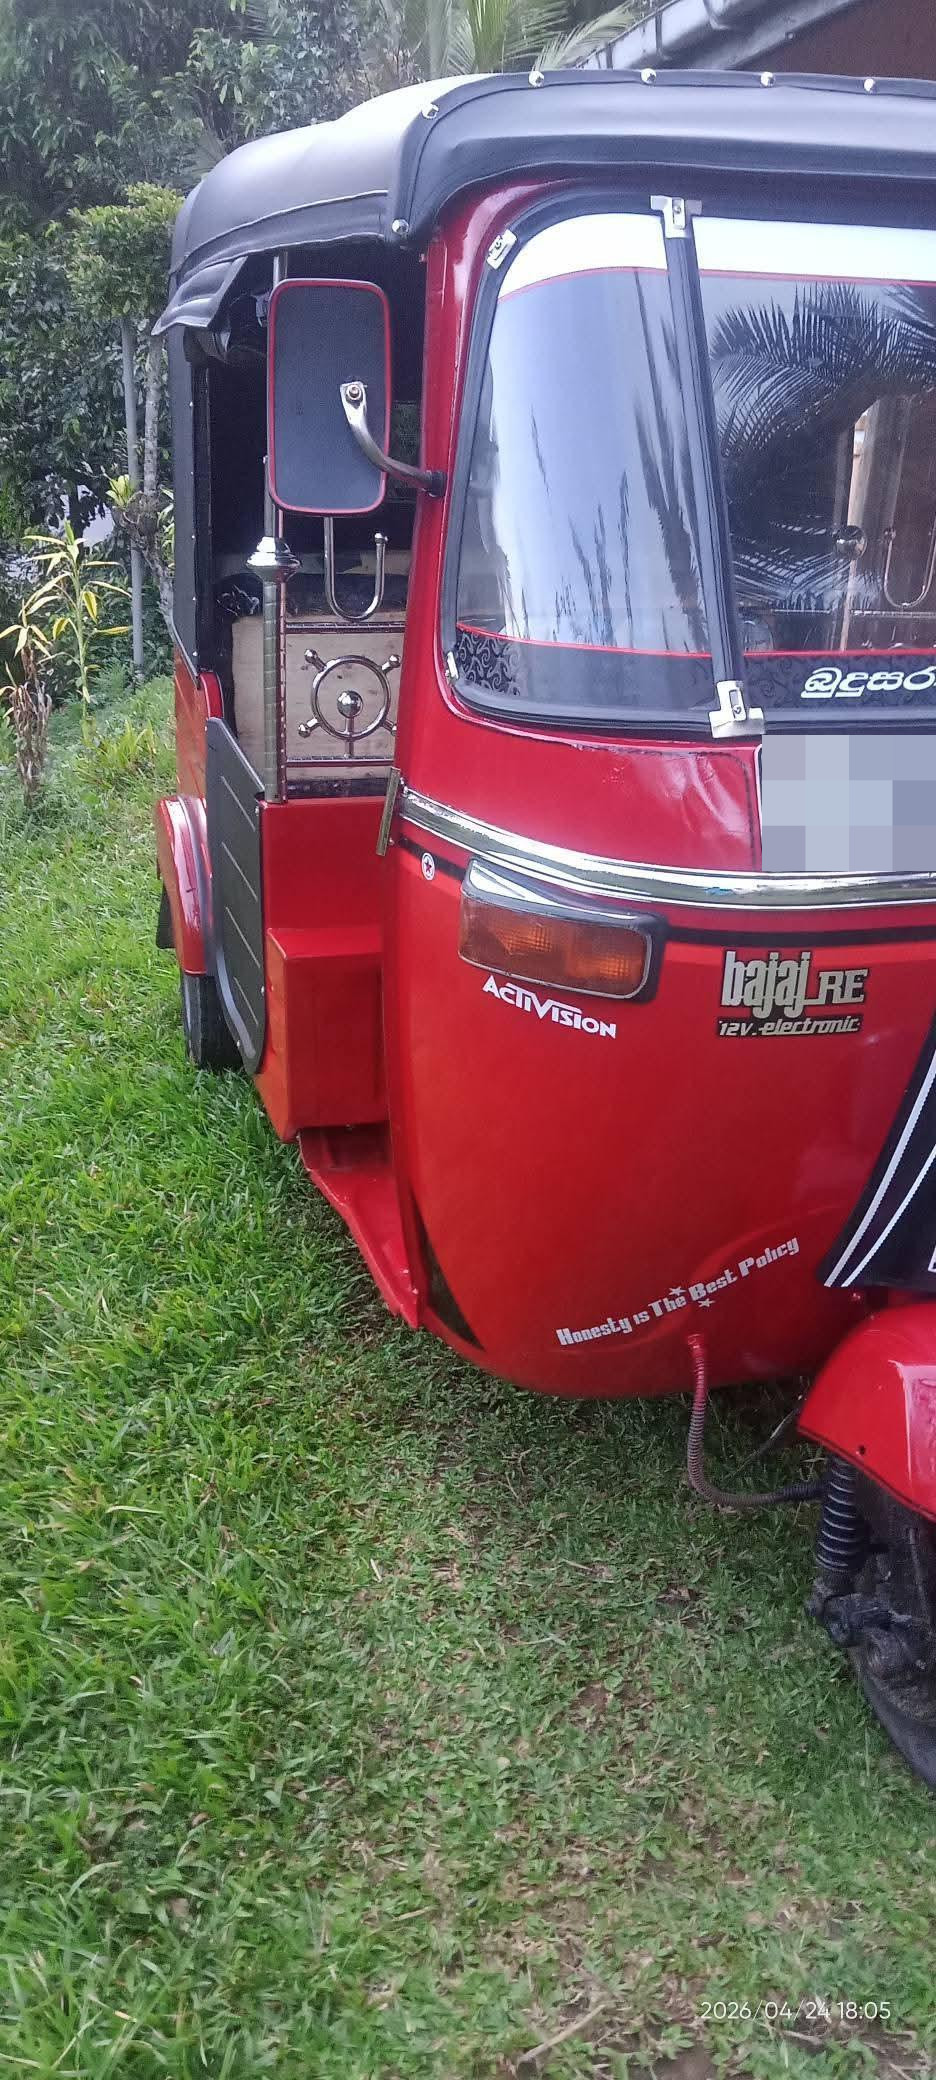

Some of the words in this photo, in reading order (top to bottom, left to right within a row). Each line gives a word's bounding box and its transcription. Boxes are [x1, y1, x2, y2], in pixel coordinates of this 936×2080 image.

[801, 666, 936, 698] බුදුසර
[721, 951, 811, 1018] bajaj
[818, 969, 868, 1004] RE
[759, 1015, 860, 1036] electronic
[556, 1317, 632, 1345] Honesty
[648, 1295, 686, 1317] The
[688, 1269, 737, 1301] Best
[738, 1237, 800, 1277] Policy
